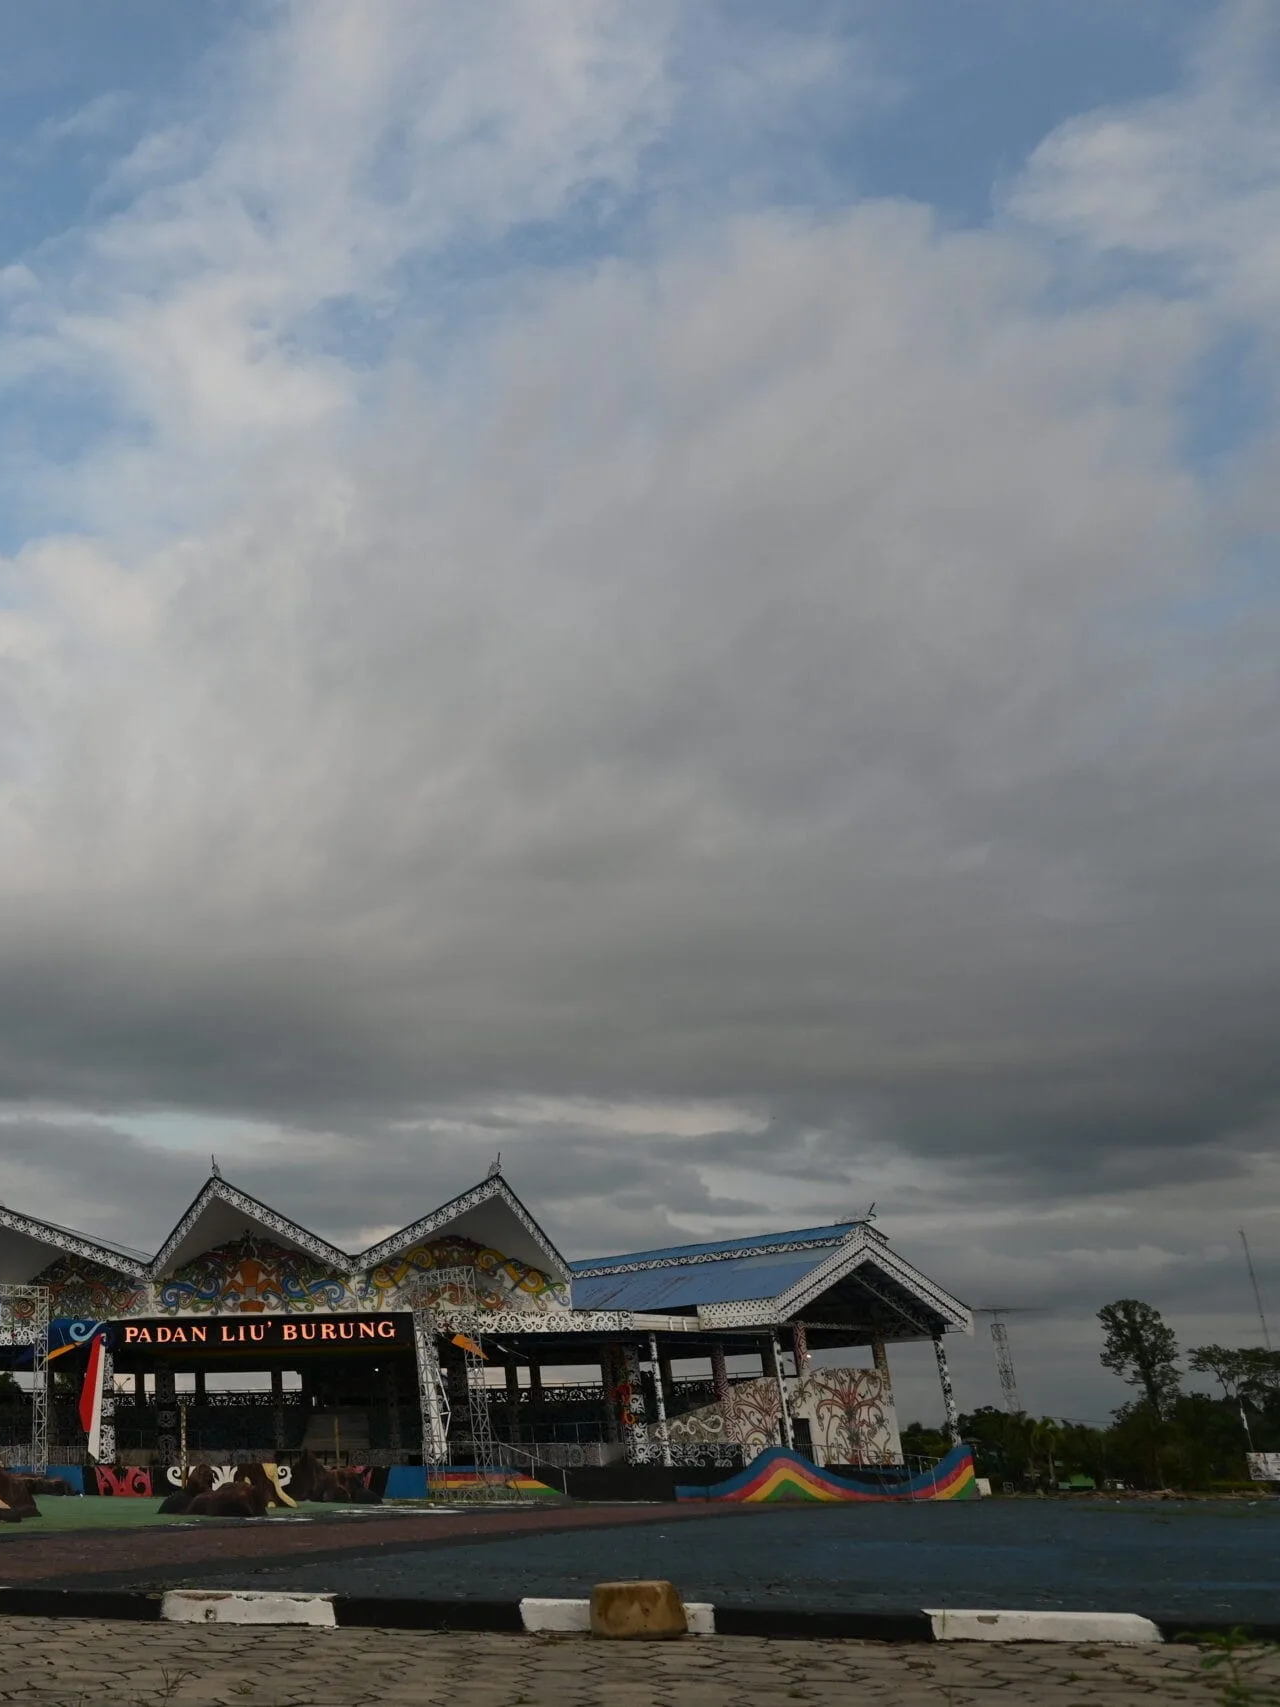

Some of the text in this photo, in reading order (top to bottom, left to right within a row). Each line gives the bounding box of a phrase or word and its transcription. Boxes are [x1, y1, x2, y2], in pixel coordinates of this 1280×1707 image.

[124, 1321, 396, 1343] PADAN LIU' BURUNG
